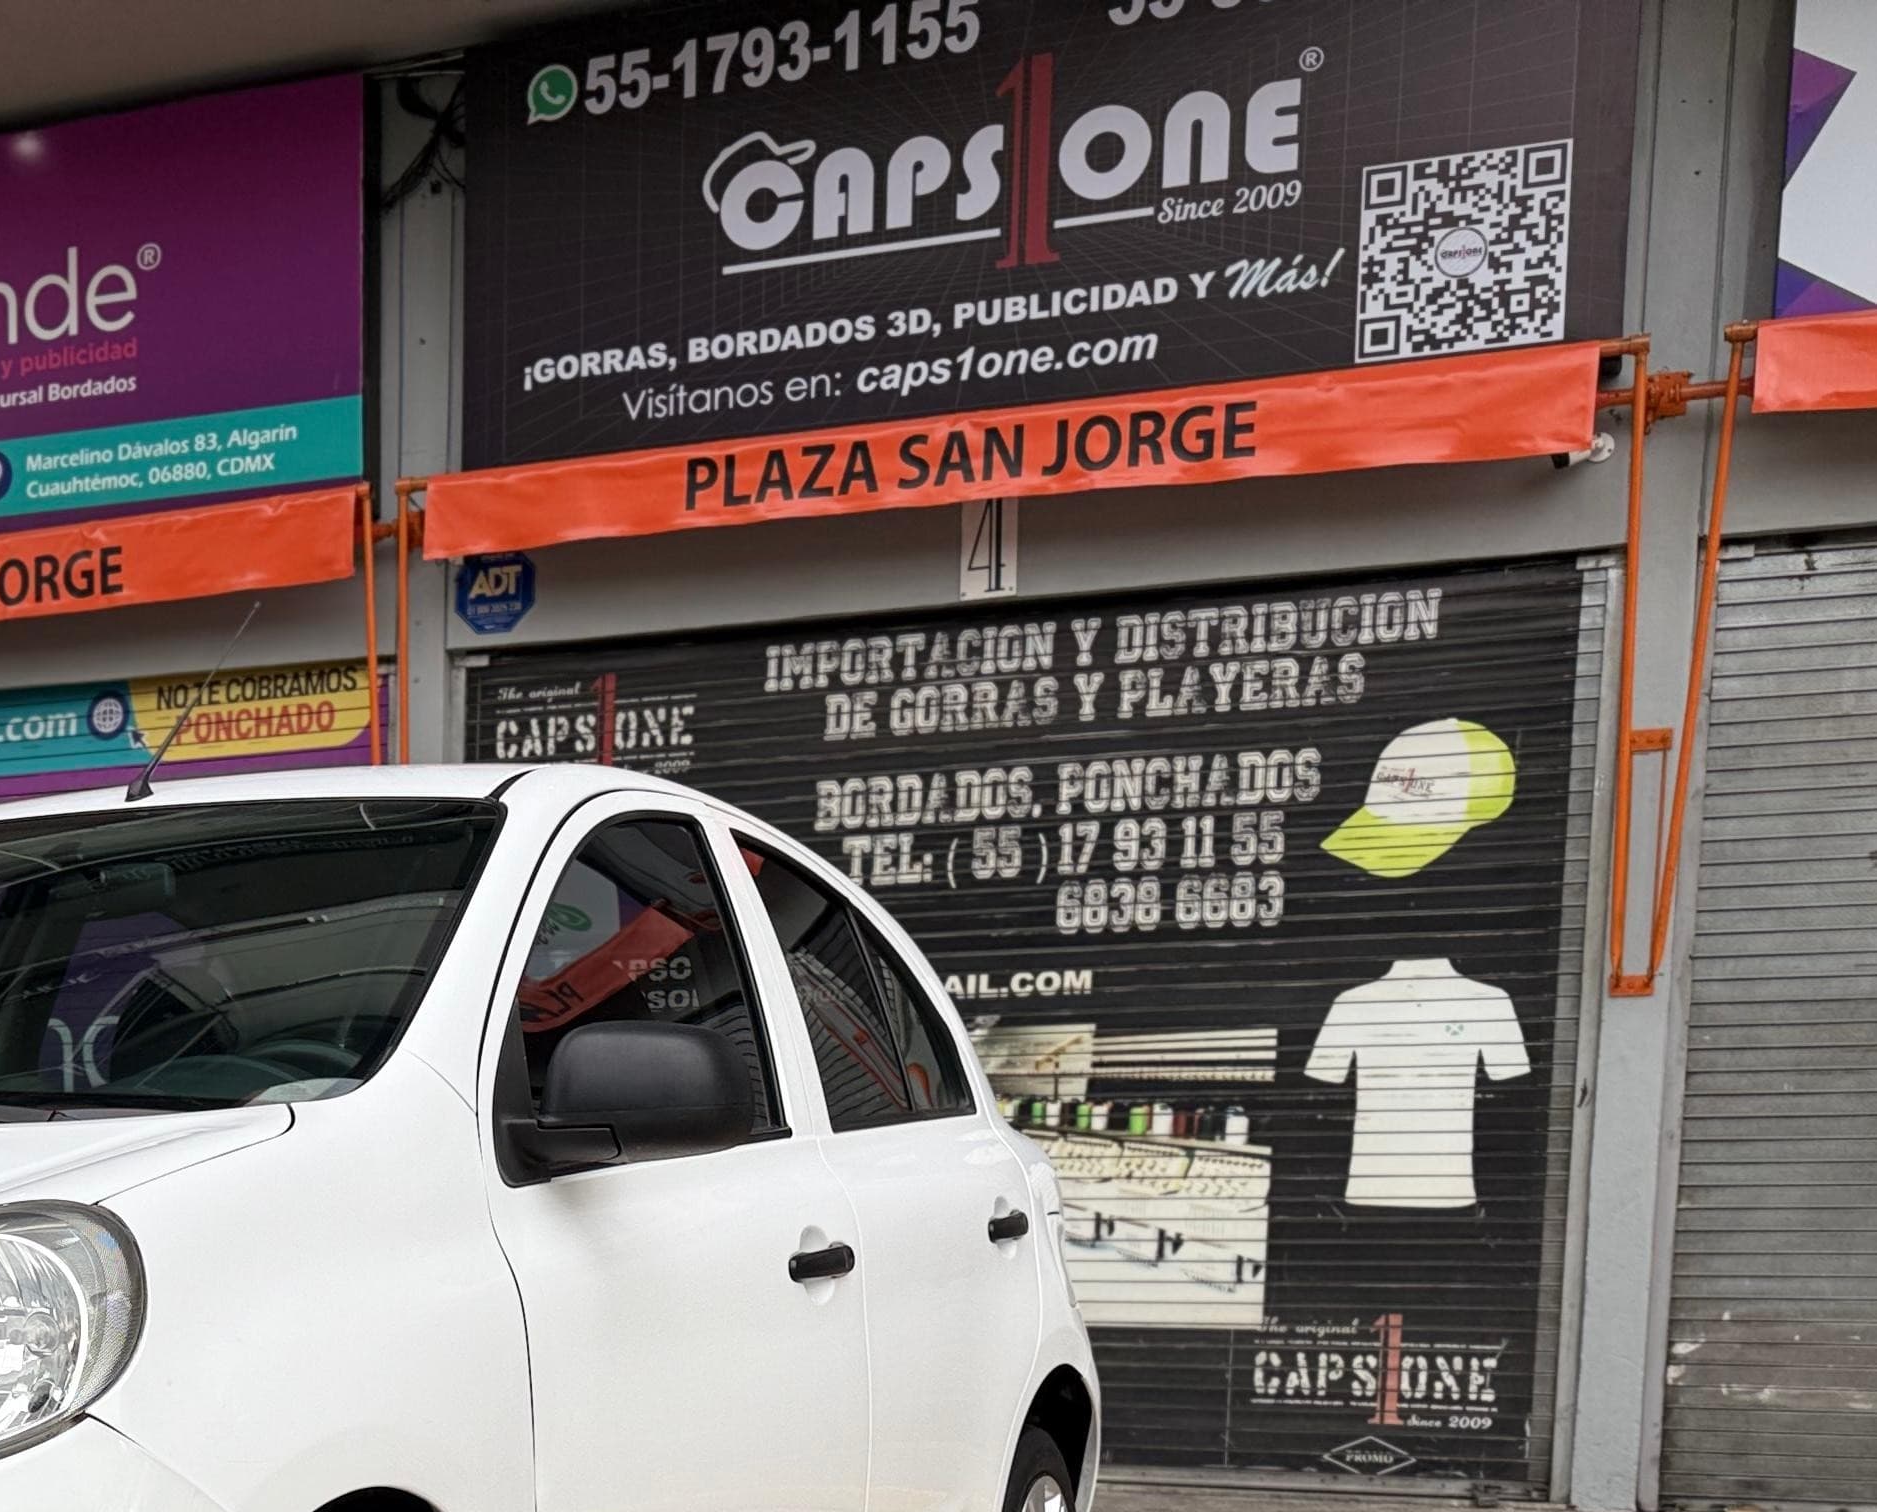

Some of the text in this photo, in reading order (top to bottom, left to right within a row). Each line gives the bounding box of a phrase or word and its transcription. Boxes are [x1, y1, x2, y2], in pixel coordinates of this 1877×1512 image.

[584, 0, 981, 116] 55-1793-1155
[1156, 180, 1303, 226] Since 2009
[524, 247, 1346, 391] ¡GORRAS, BORDADOS 3D, PUBLICIDAD Y Más!
[1, 357, 13, 381] y
[21, 339, 138, 376] publicidad
[48, 374, 137, 402] Bordados
[623, 332, 1159, 421] Visítanos en: caps1one.com
[26, 448, 113, 473] Marcelino
[117, 436, 190, 462] Dávalos
[193, 431, 223, 454] 83,
[26, 452, 276, 499] Cuauhtémoc, 06880, CDMX
[685, 401, 1257, 510] PLAZA SAN JORGE
[966, 497, 1006, 593] 4
[468, 565, 522, 600] ADT
[764, 588, 1442, 692] IMPORTACION Y DISTRIBUCION
[156, 666, 357, 711] NO TE COBRAMOS
[824, 652, 1366, 741] DE GORRAS Y PLAYERAS
[175, 700, 336, 746] PONCHADO
[1055, 747, 1322, 815] PONCHADOS
[842, 832, 933, 886] TEL:
[1056, 821, 1100, 875] 17
[1112, 817, 1167, 871] 93
[1180, 815, 1216, 868] 11
[1230, 810, 1285, 865] 55
[1055, 870, 1285, 935] 6838 6683
[1448, 1415, 1493, 1430] 2009
